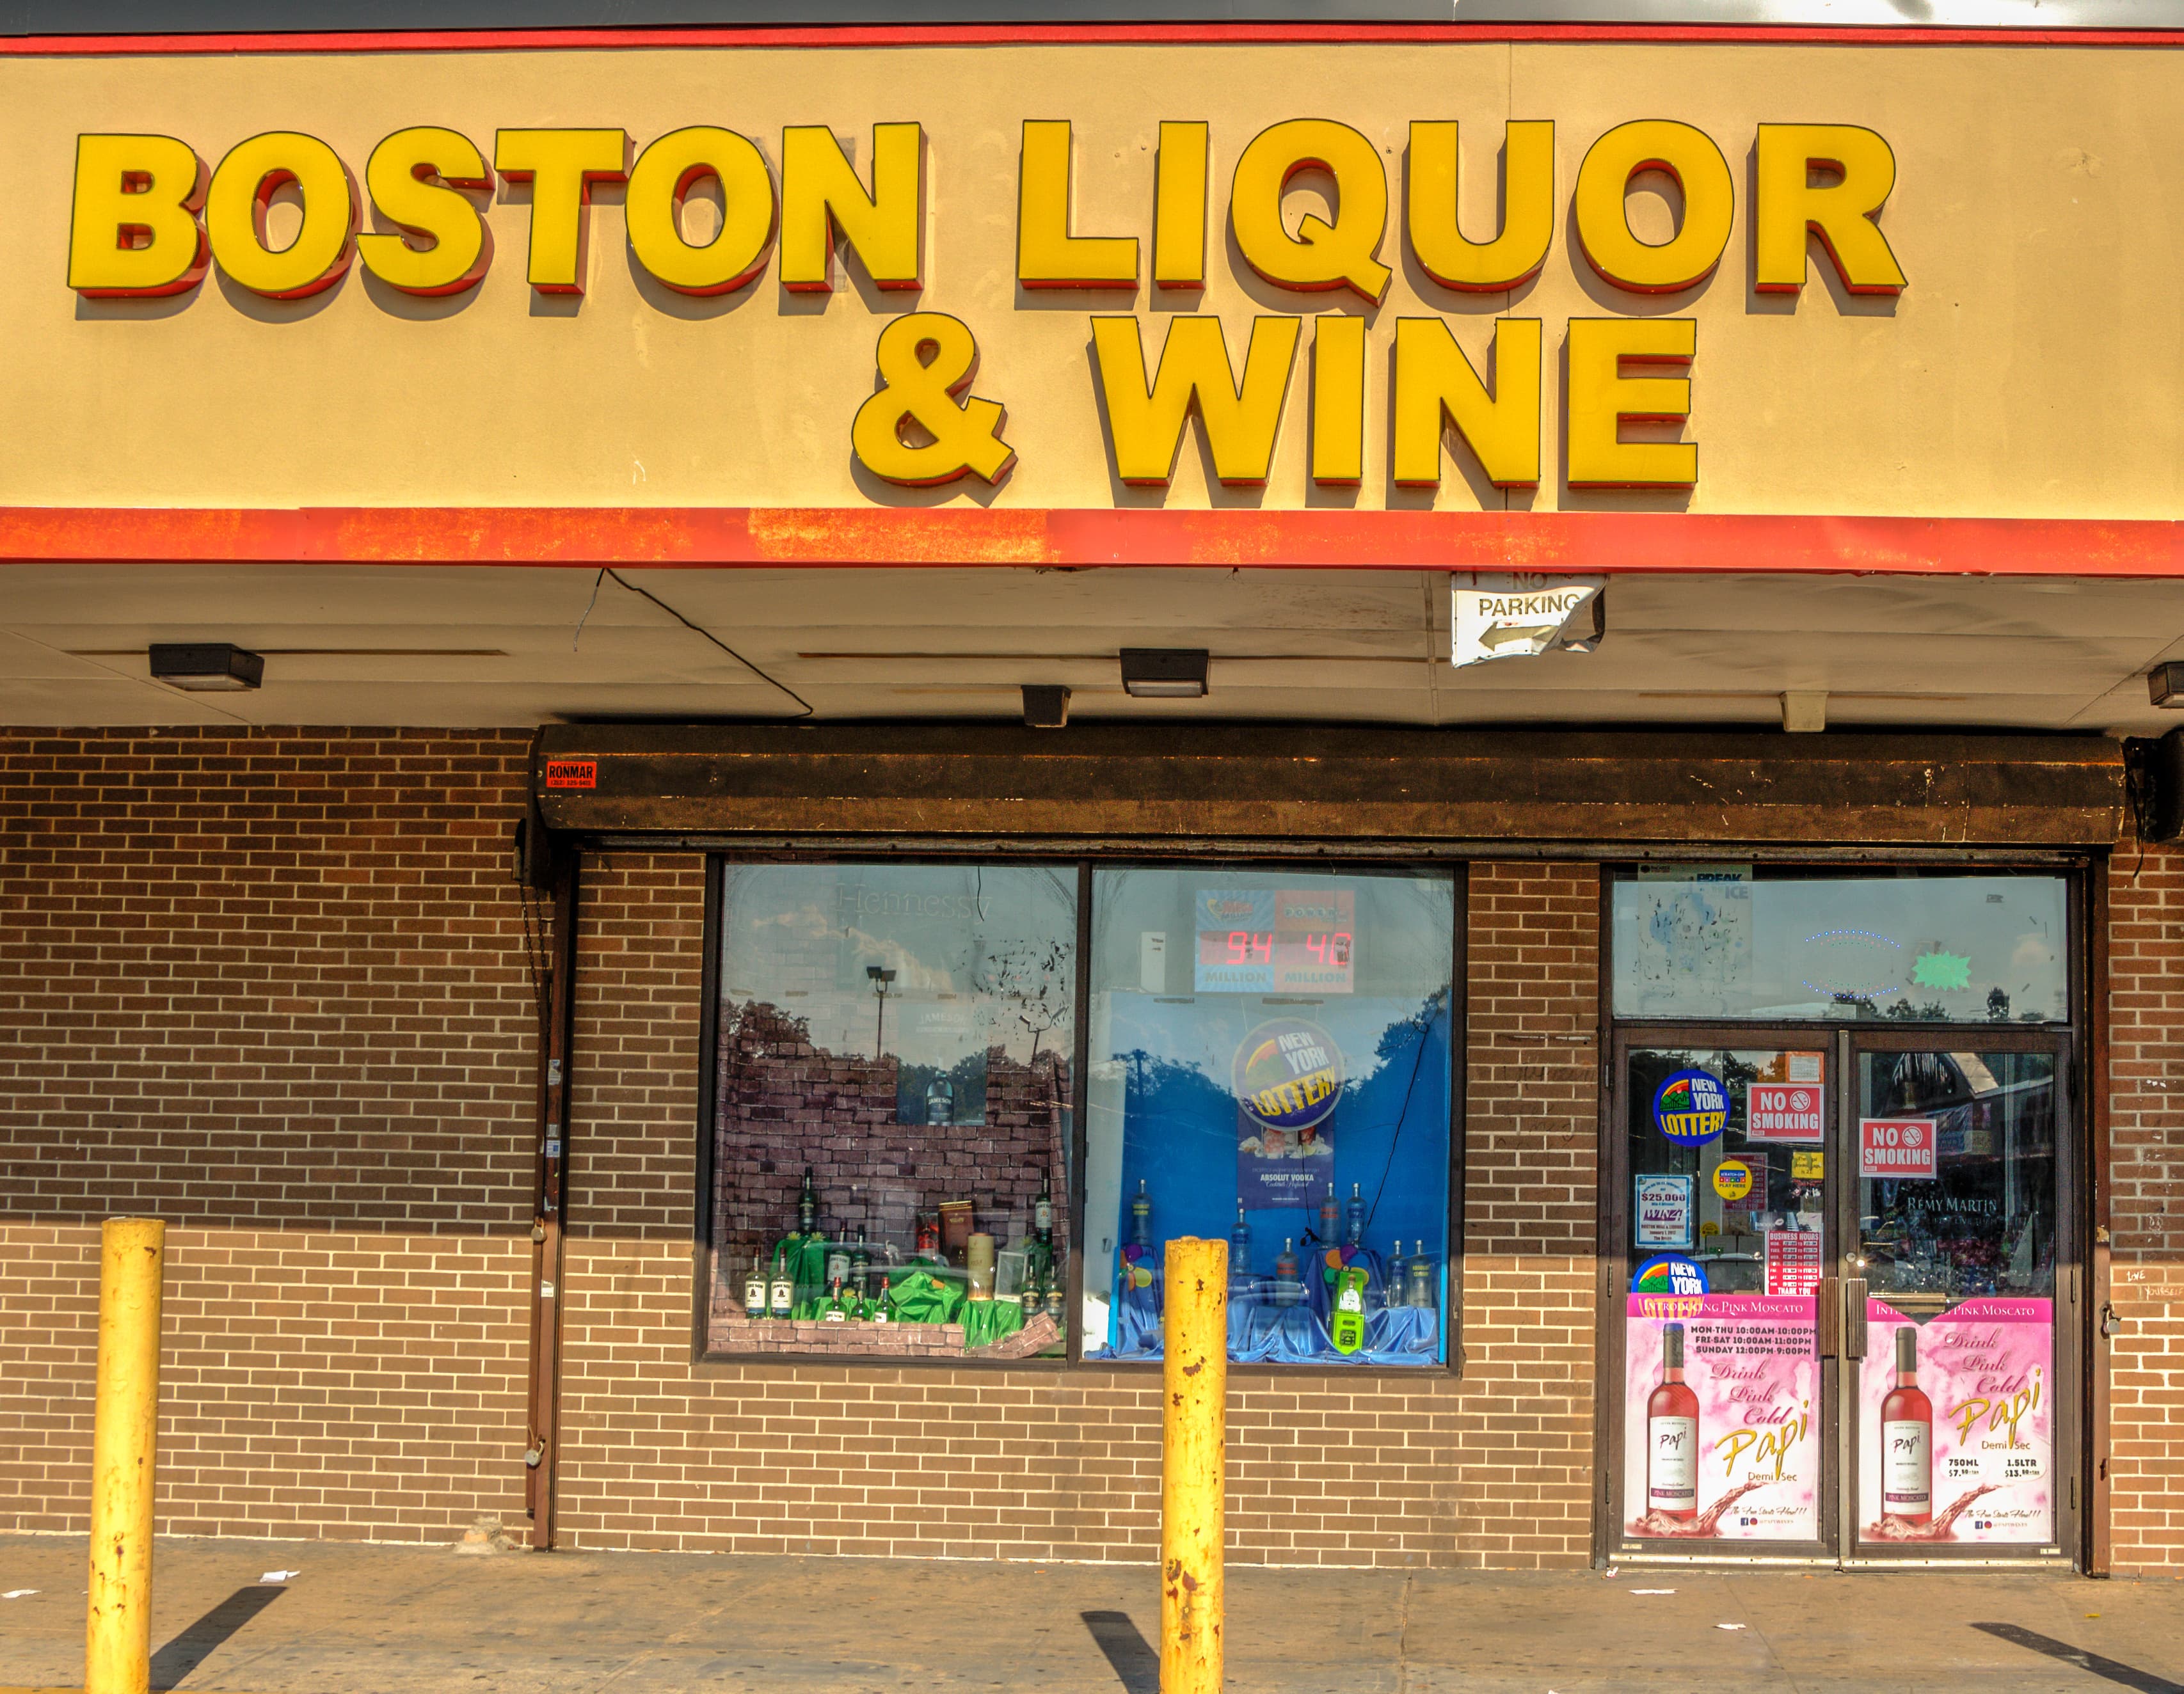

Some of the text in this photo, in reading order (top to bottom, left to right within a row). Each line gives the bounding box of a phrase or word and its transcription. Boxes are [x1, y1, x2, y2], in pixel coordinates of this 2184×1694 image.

[66, 118, 1909, 305] BOSTON LIQUOR
[850, 312, 1699, 490] & WINE
[1512, 571, 1547, 590] NO
[1479, 594, 1580, 617] PARKING
[549, 765, 593, 779] RONMAR
[1725, 885, 1749, 899] ICE
[834, 883, 992, 926] Hennessy
[1225, 931, 1272, 965] 94
[1306, 931, 1352, 965] 40
[1205, 972, 1267, 983] MILLION
[1284, 972, 1347, 983] MILLION
[1278, 1031, 1315, 1052] NEW
[1284, 1046, 1330, 1075] YORK
[1250, 1065, 1335, 1116] LOTTERY
[1691, 1078, 1717, 1093] NEW
[1693, 1093, 1725, 1110] YORK
[1760, 1091, 1786, 1111] NO
[1660, 1111, 1726, 1136] LOTTERY
[1752, 1112, 1819, 1130] SMOKING
[1872, 1127, 1899, 1146] NO
[1864, 1148, 1931, 1165] SMOKING
[1641, 1193, 1686, 1201] $25,000
[1946, 1197, 1997, 1212] MARTIN
[1670, 1262, 1696, 1278] NEW
[2126, 1269, 2146, 1282] LOVE
[1671, 1276, 1703, 1295] YORK
[2144, 1285, 2183, 1301] YOURSELF
[1638, 1296, 1705, 1321] LOTTERY
[1721, 1301, 1747, 1313] PINK
[1750, 1301, 1803, 1313] MOSCATO
[1954, 1304, 1979, 1315] PINK
[1982, 1304, 2035, 1316] MOSCATO
[1733, 1336, 1812, 1345] 10:00AM-11:00PM
[1736, 1327, 1817, 1335] 10:00AM-10:00PM
[1943, 1328, 2001, 1349] Drink
[1735, 1347, 1811, 1355] 12:00PM-9:00PM
[1710, 1359, 1769, 1381] Drink
[1962, 1351, 2011, 1372] Pink
[1728, 1381, 1779, 1403] Pink
[1976, 1375, 2027, 1393] Cold
[1743, 1405, 1794, 1425] Cold
[1947, 1368, 2041, 1450] Papi
[1659, 1426, 1687, 1450] Papi
[1714, 1400, 1809, 1481] Papi
[1893, 1430, 1921, 1455] Papi
[1981, 1440, 2030, 1450] Demi Sec
[1748, 1471, 1797, 1482] Demi Sec
